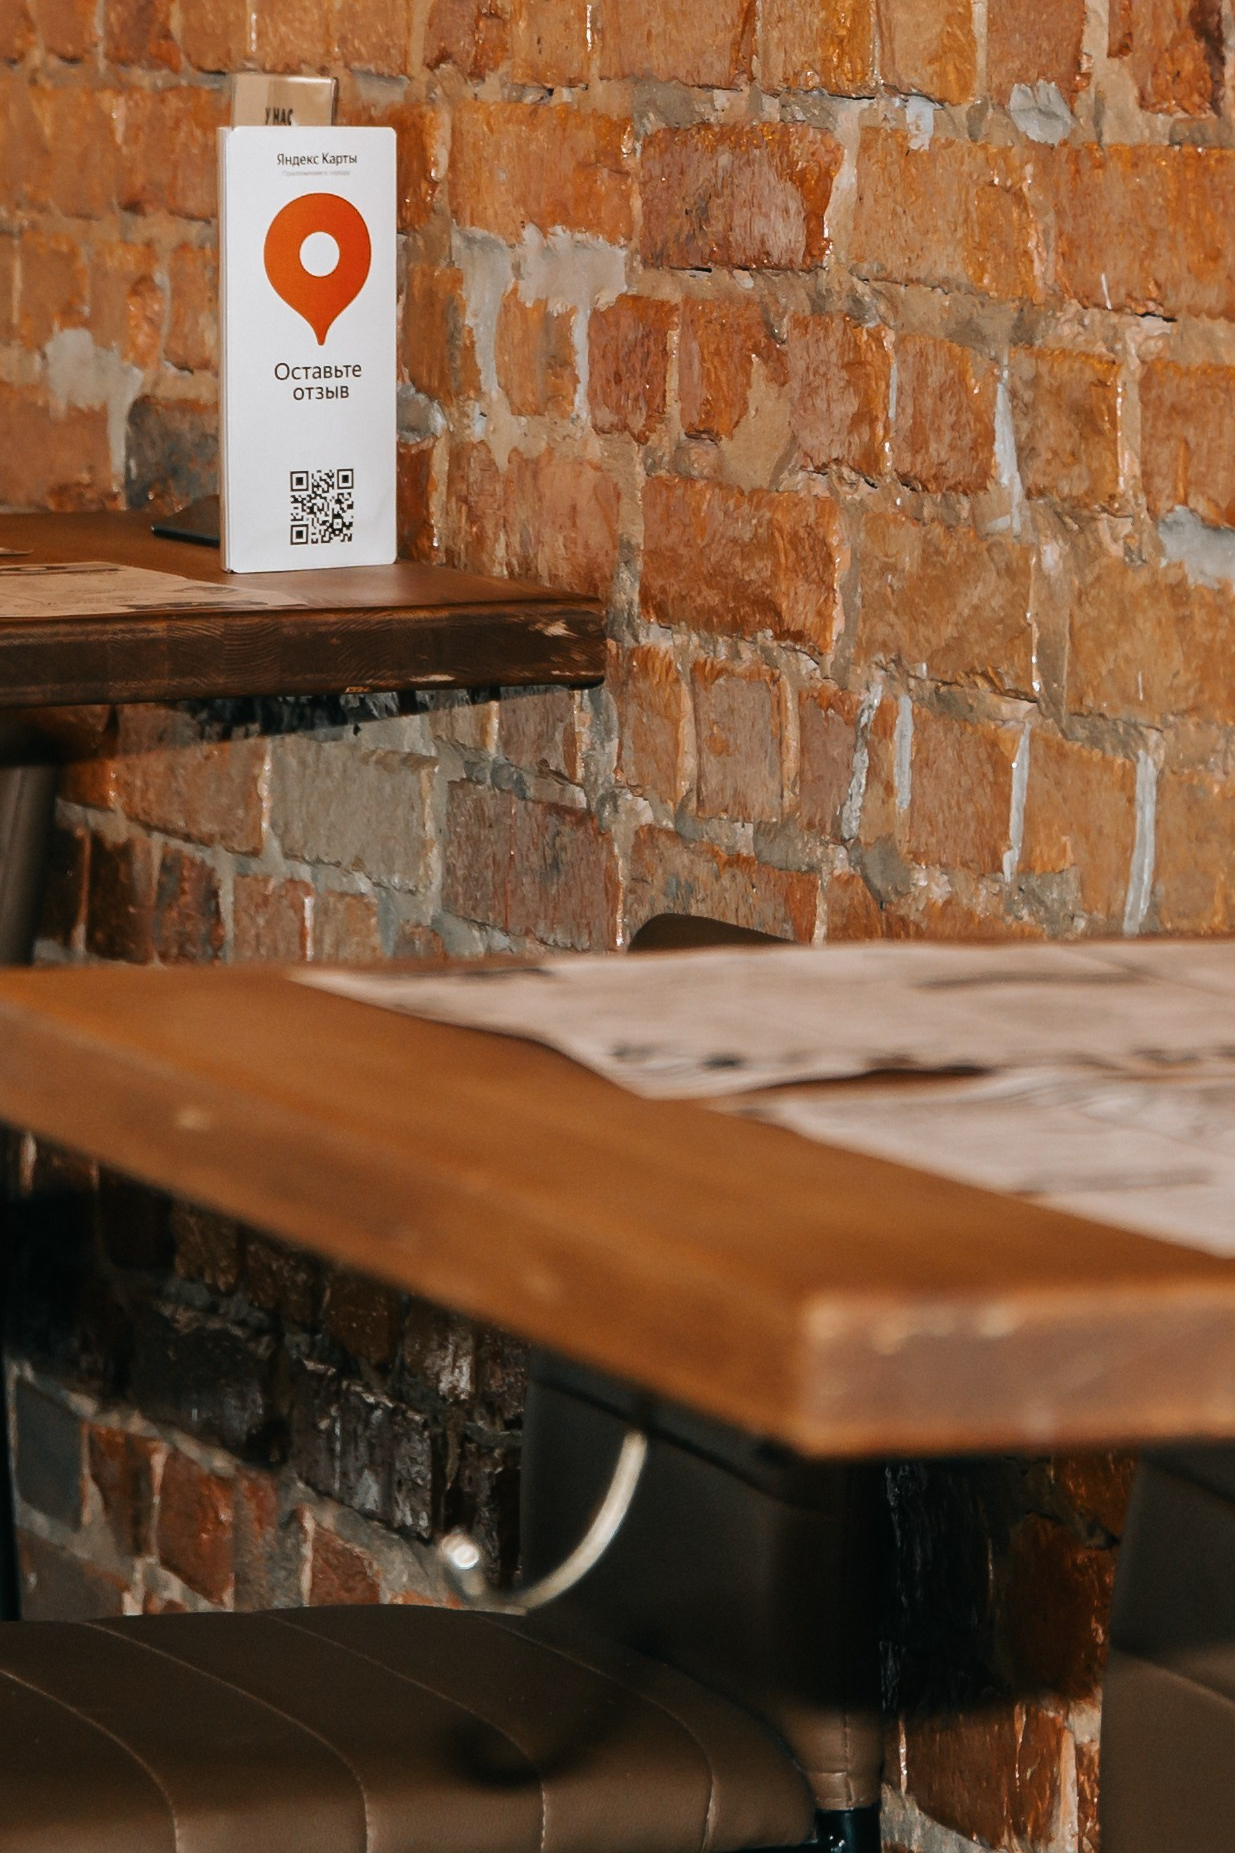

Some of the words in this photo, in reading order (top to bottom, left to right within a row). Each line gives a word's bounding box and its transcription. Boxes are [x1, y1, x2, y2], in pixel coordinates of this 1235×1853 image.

[277, 153, 319, 166] Яндекс
[322, 152, 358, 166] Карты
[274, 362, 362, 381] Оставьте
[292, 385, 350, 401] отзыв
